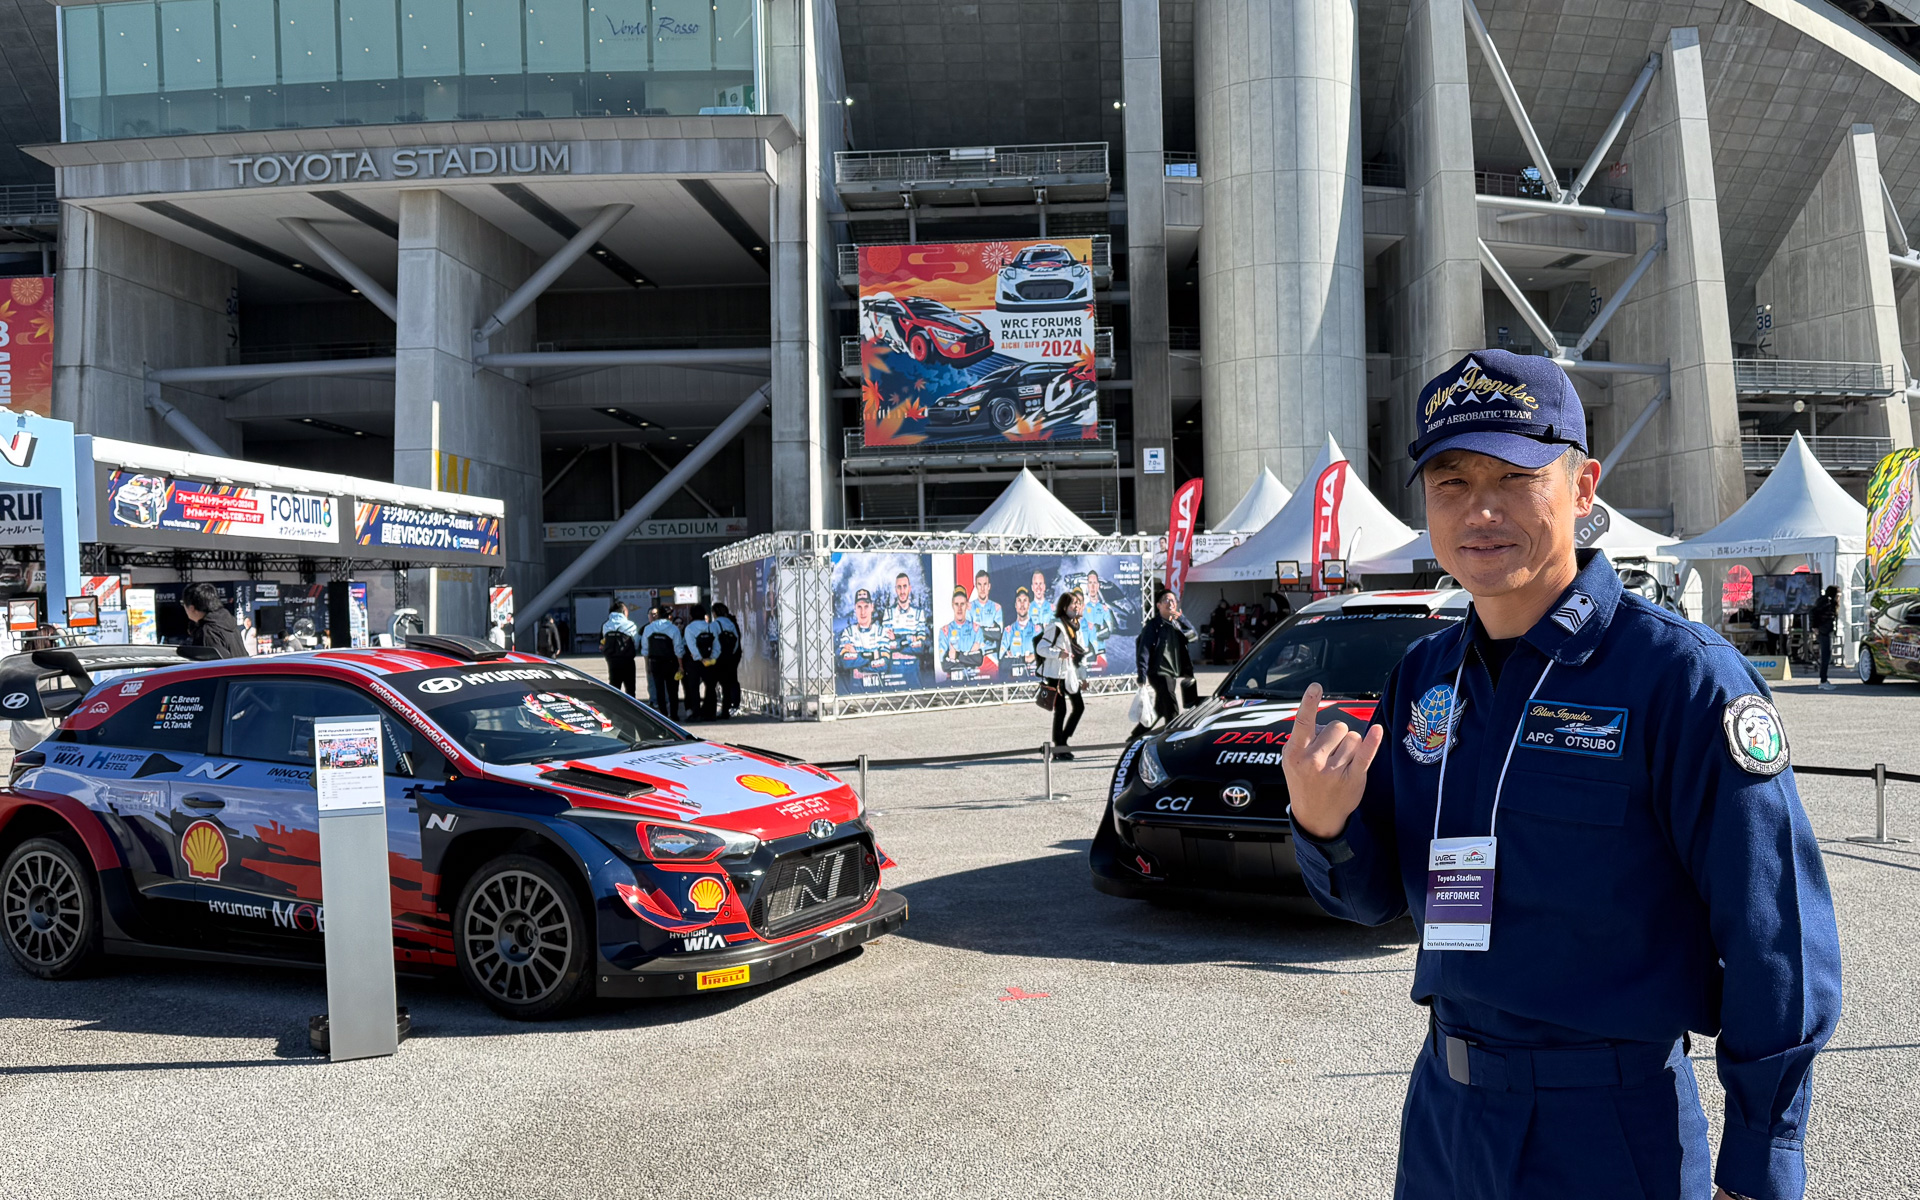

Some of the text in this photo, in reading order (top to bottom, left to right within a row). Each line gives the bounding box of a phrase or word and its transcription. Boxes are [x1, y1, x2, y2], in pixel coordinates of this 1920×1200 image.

[656, 16, 699, 36] Rosso
[229, 145, 571, 185] TOYOTA STADIUM
[1000, 316, 1082, 329] WRC FORUM8
[1756, 314, 1773, 329] 38
[1002, 328, 1082, 340] RALLY JAPAN
[1041, 340, 1083, 358] 2024
[1425, 366, 1540, 423] Blue Impulse
[1447, 410, 1501, 425] AEROBATIC
[1502, 409, 1532, 420] TEAM
[270, 494, 332, 527] FORUM8
[560, 527, 576, 537] TO
[578, 524, 643, 538] TOYA
[648, 521, 719, 536] STADIUM
[1324, 613, 1374, 622] TOYOTA
[460, 669, 553, 686] HYUNDAI
[120, 682, 143, 694] OMP
[170, 695, 200, 704] C.Breen
[169, 704, 204, 712] T.Neuville
[1529, 705, 1593, 722] Blue Impulse
[165, 712, 194, 720] D.Sordo
[369, 681, 460, 761] motorsport.hyundai.com
[163, 721, 192, 729] O.Tanak
[1525, 731, 1617, 751] APG OTSUBO
[110, 753, 146, 763] HYUNDAI
[104, 762, 129, 771] STEEL
[775, 796, 830, 816] Hanon
[792, 805, 831, 820] SYSTEMS
[1435, 854, 1457, 862] WRC
[1437, 874, 1482, 883] Toyota Stadium
[1436, 891, 1480, 900] PERFORMER
[208, 899, 267, 919] HYUNDAI
[684, 932, 726, 952] WIA
[701, 969, 745, 986] PIRELLI
